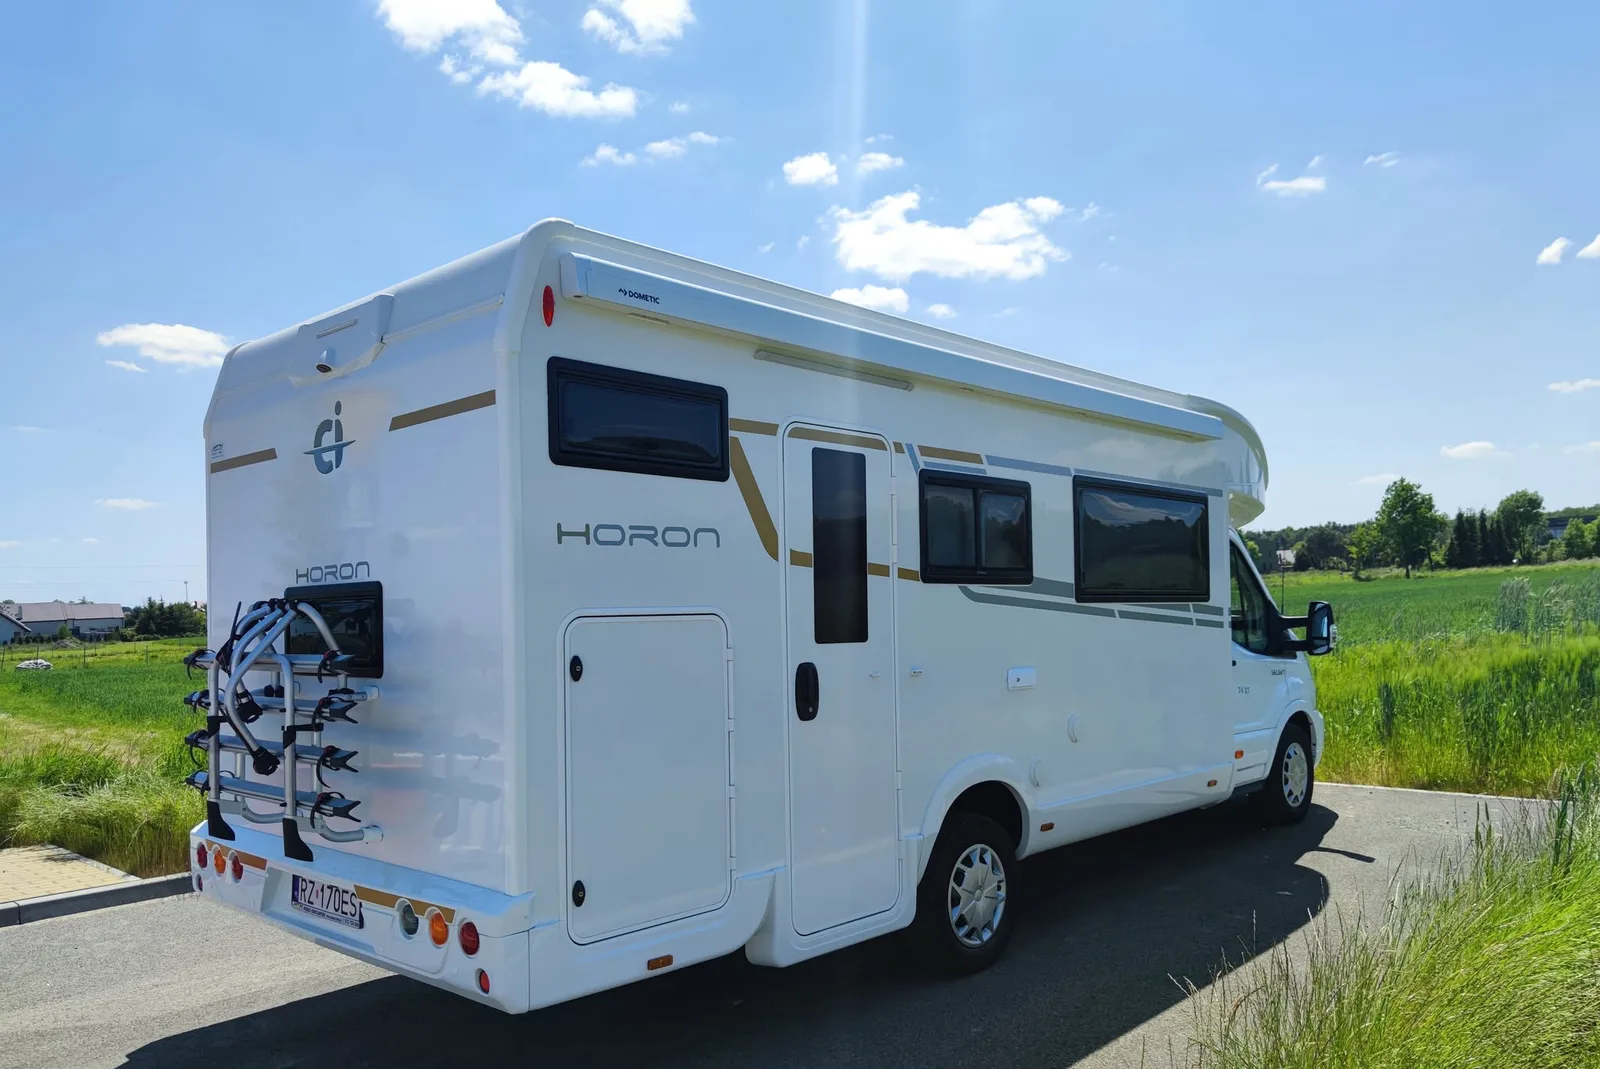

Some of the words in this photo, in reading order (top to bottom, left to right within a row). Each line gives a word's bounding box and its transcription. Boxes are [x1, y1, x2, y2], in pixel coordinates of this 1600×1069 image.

[628, 290, 660, 304] DOMETIC
[556, 522, 721, 548] HORON
[295, 561, 370, 584] HORON
[300, 878, 315, 905] RZ
[320, 884, 357, 917] 170ES
